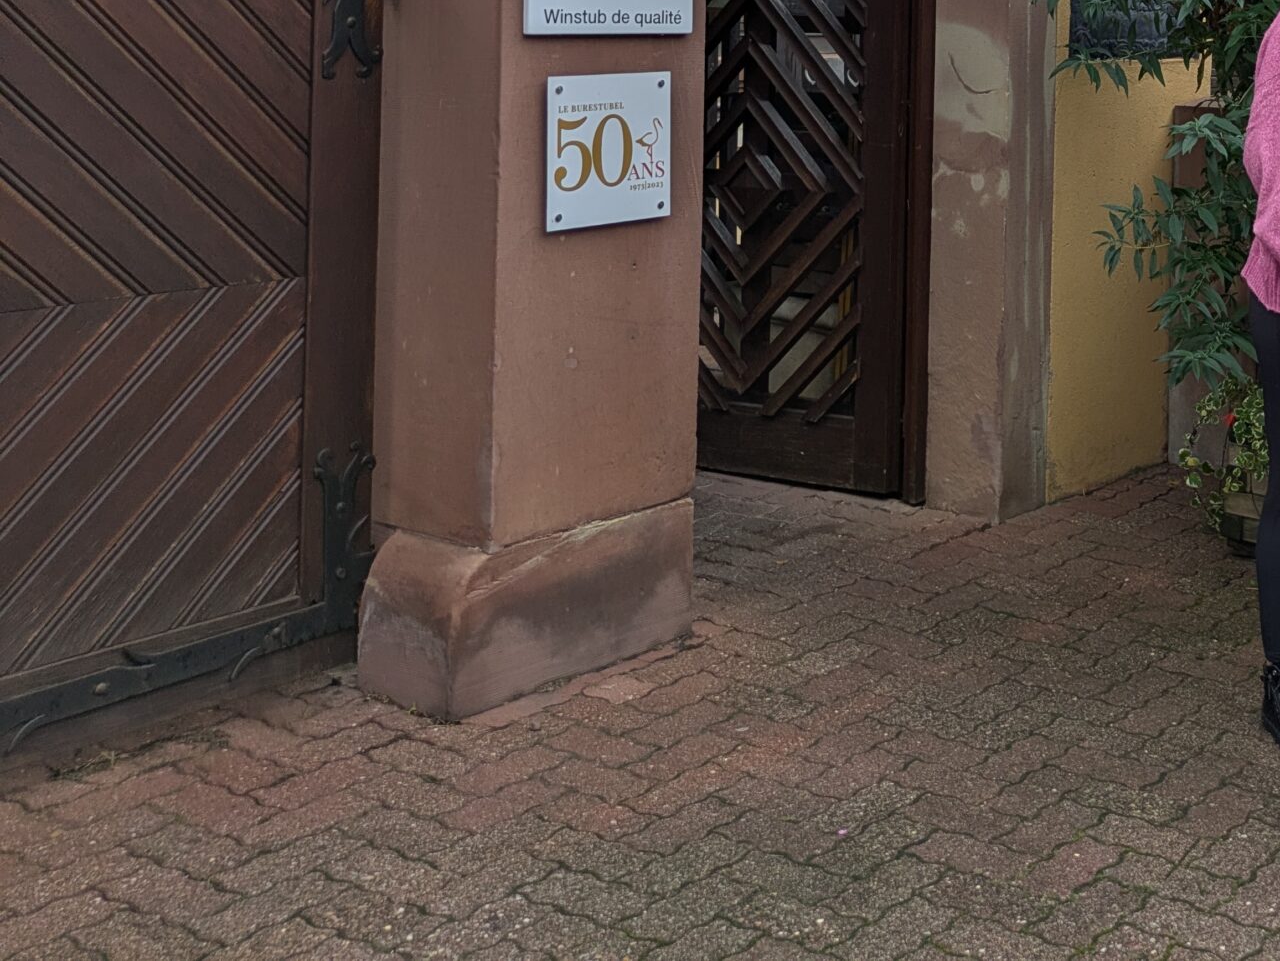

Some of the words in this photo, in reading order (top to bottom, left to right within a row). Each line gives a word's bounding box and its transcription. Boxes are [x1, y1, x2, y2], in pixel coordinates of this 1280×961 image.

[544, 8, 607, 24] Winstub
[611, 9, 630, 24] de
[634, 9, 682, 27] qualité
[558, 105, 569, 114] LE
[571, 102, 624, 112] BURESTUBEL
[554, 113, 633, 192] 50
[627, 160, 665, 181] ANS
